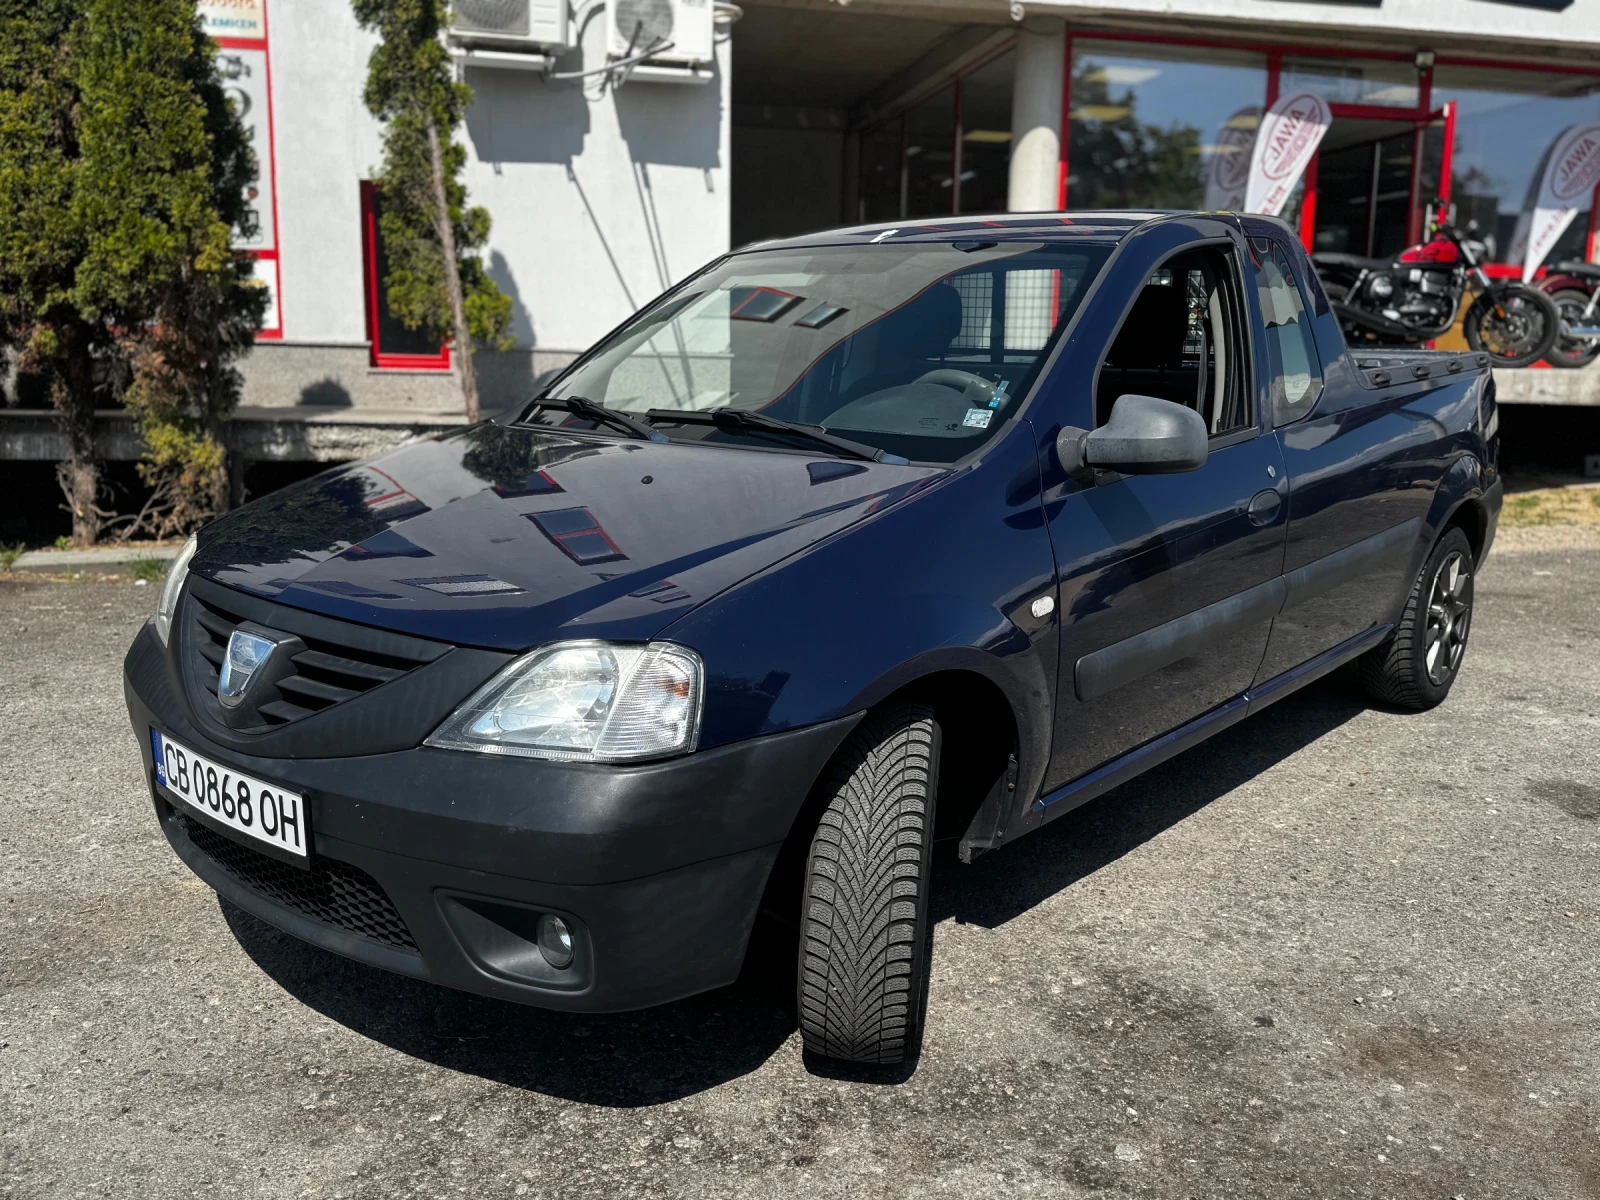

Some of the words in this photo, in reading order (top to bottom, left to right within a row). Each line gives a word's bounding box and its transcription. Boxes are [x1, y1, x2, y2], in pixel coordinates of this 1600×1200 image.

[1269, 108, 1305, 161] JAWA
[1559, 136, 1597, 182] JAWA
[156, 760, 166, 778] BG
[164, 742, 190, 795] CB
[193, 759, 253, 827] 0868
[259, 789, 301, 848] OH
